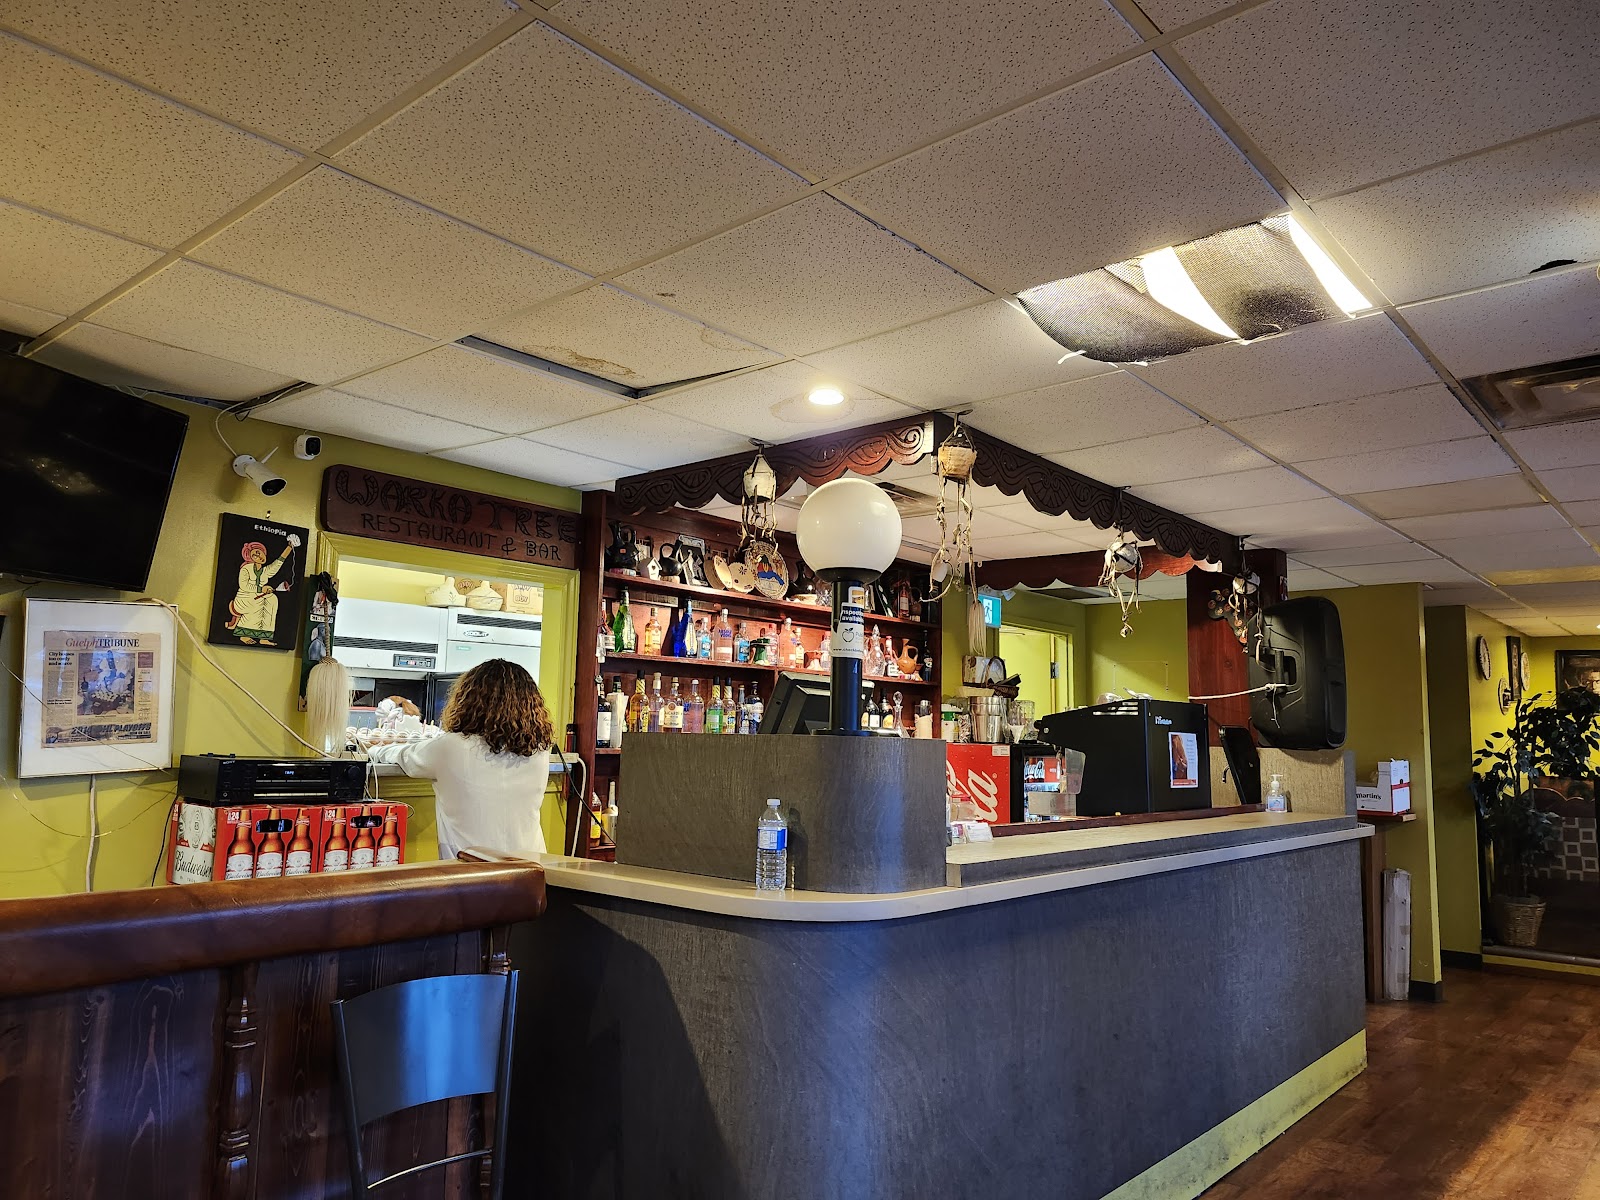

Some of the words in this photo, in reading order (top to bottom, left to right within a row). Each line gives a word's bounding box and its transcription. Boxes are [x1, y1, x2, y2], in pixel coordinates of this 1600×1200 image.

[335, 470, 473, 525] WARKA
[479, 499, 578, 544] TREE
[254, 524, 287, 537] Ethiopia
[361, 513, 497, 550] RESTAURANT
[501, 536, 517, 556] &
[525, 540, 562, 561] BAR
[232, 811, 240, 821] 24
[174, 849, 214, 878] Budweiser
